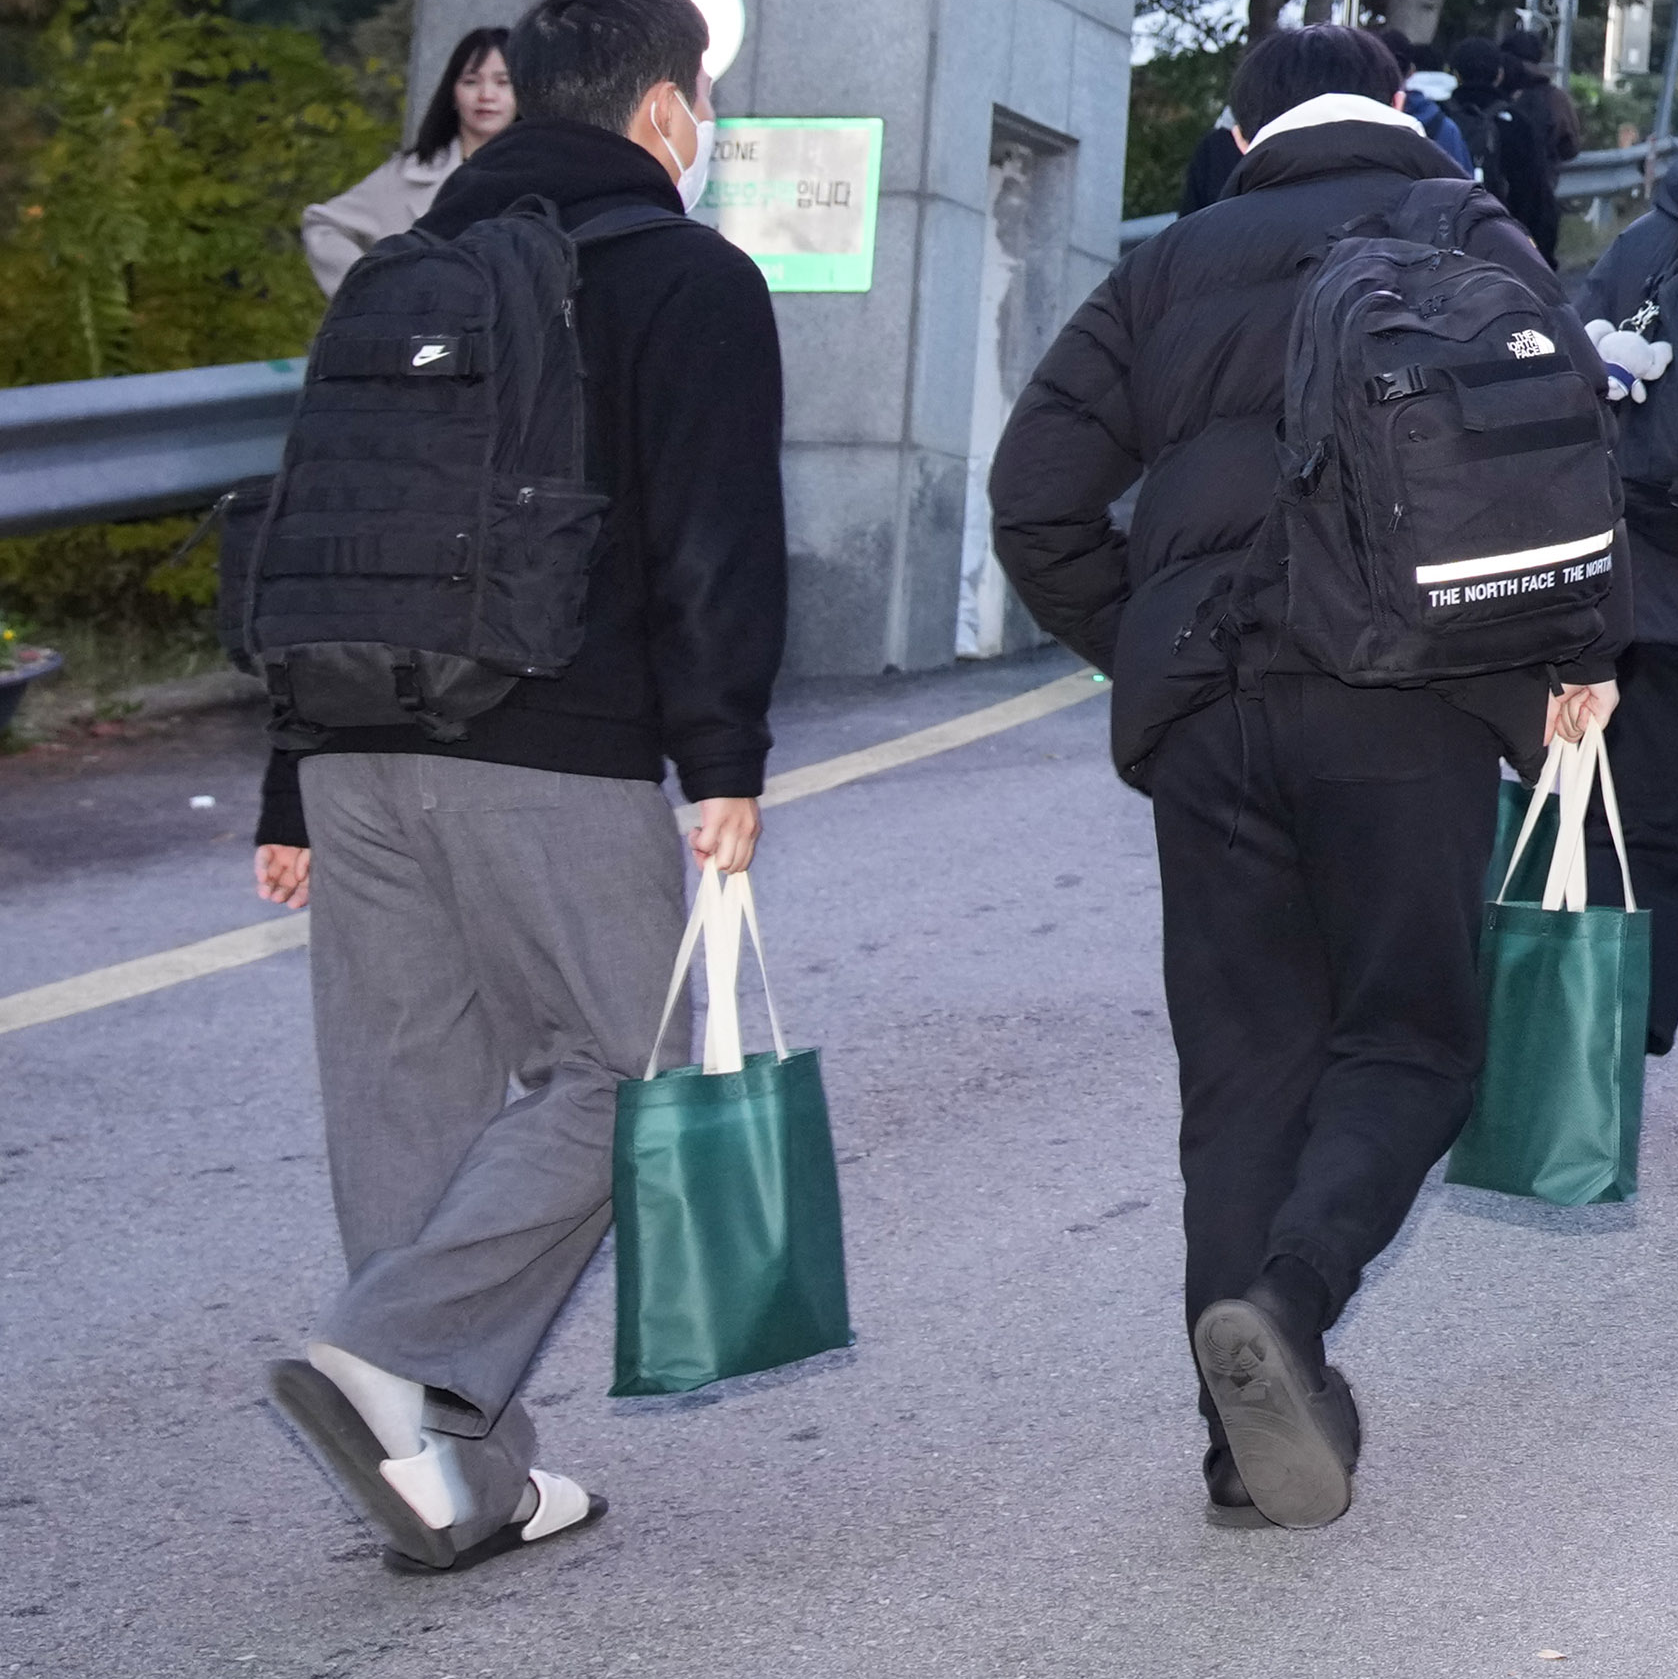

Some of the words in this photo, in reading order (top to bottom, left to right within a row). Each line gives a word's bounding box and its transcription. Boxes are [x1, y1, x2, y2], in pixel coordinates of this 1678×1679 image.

[1428, 587, 1461, 608] THE
[1464, 578, 1518, 603] NORTH
[1521, 570, 1556, 594] FACE
[1562, 566, 1585, 584] THE
